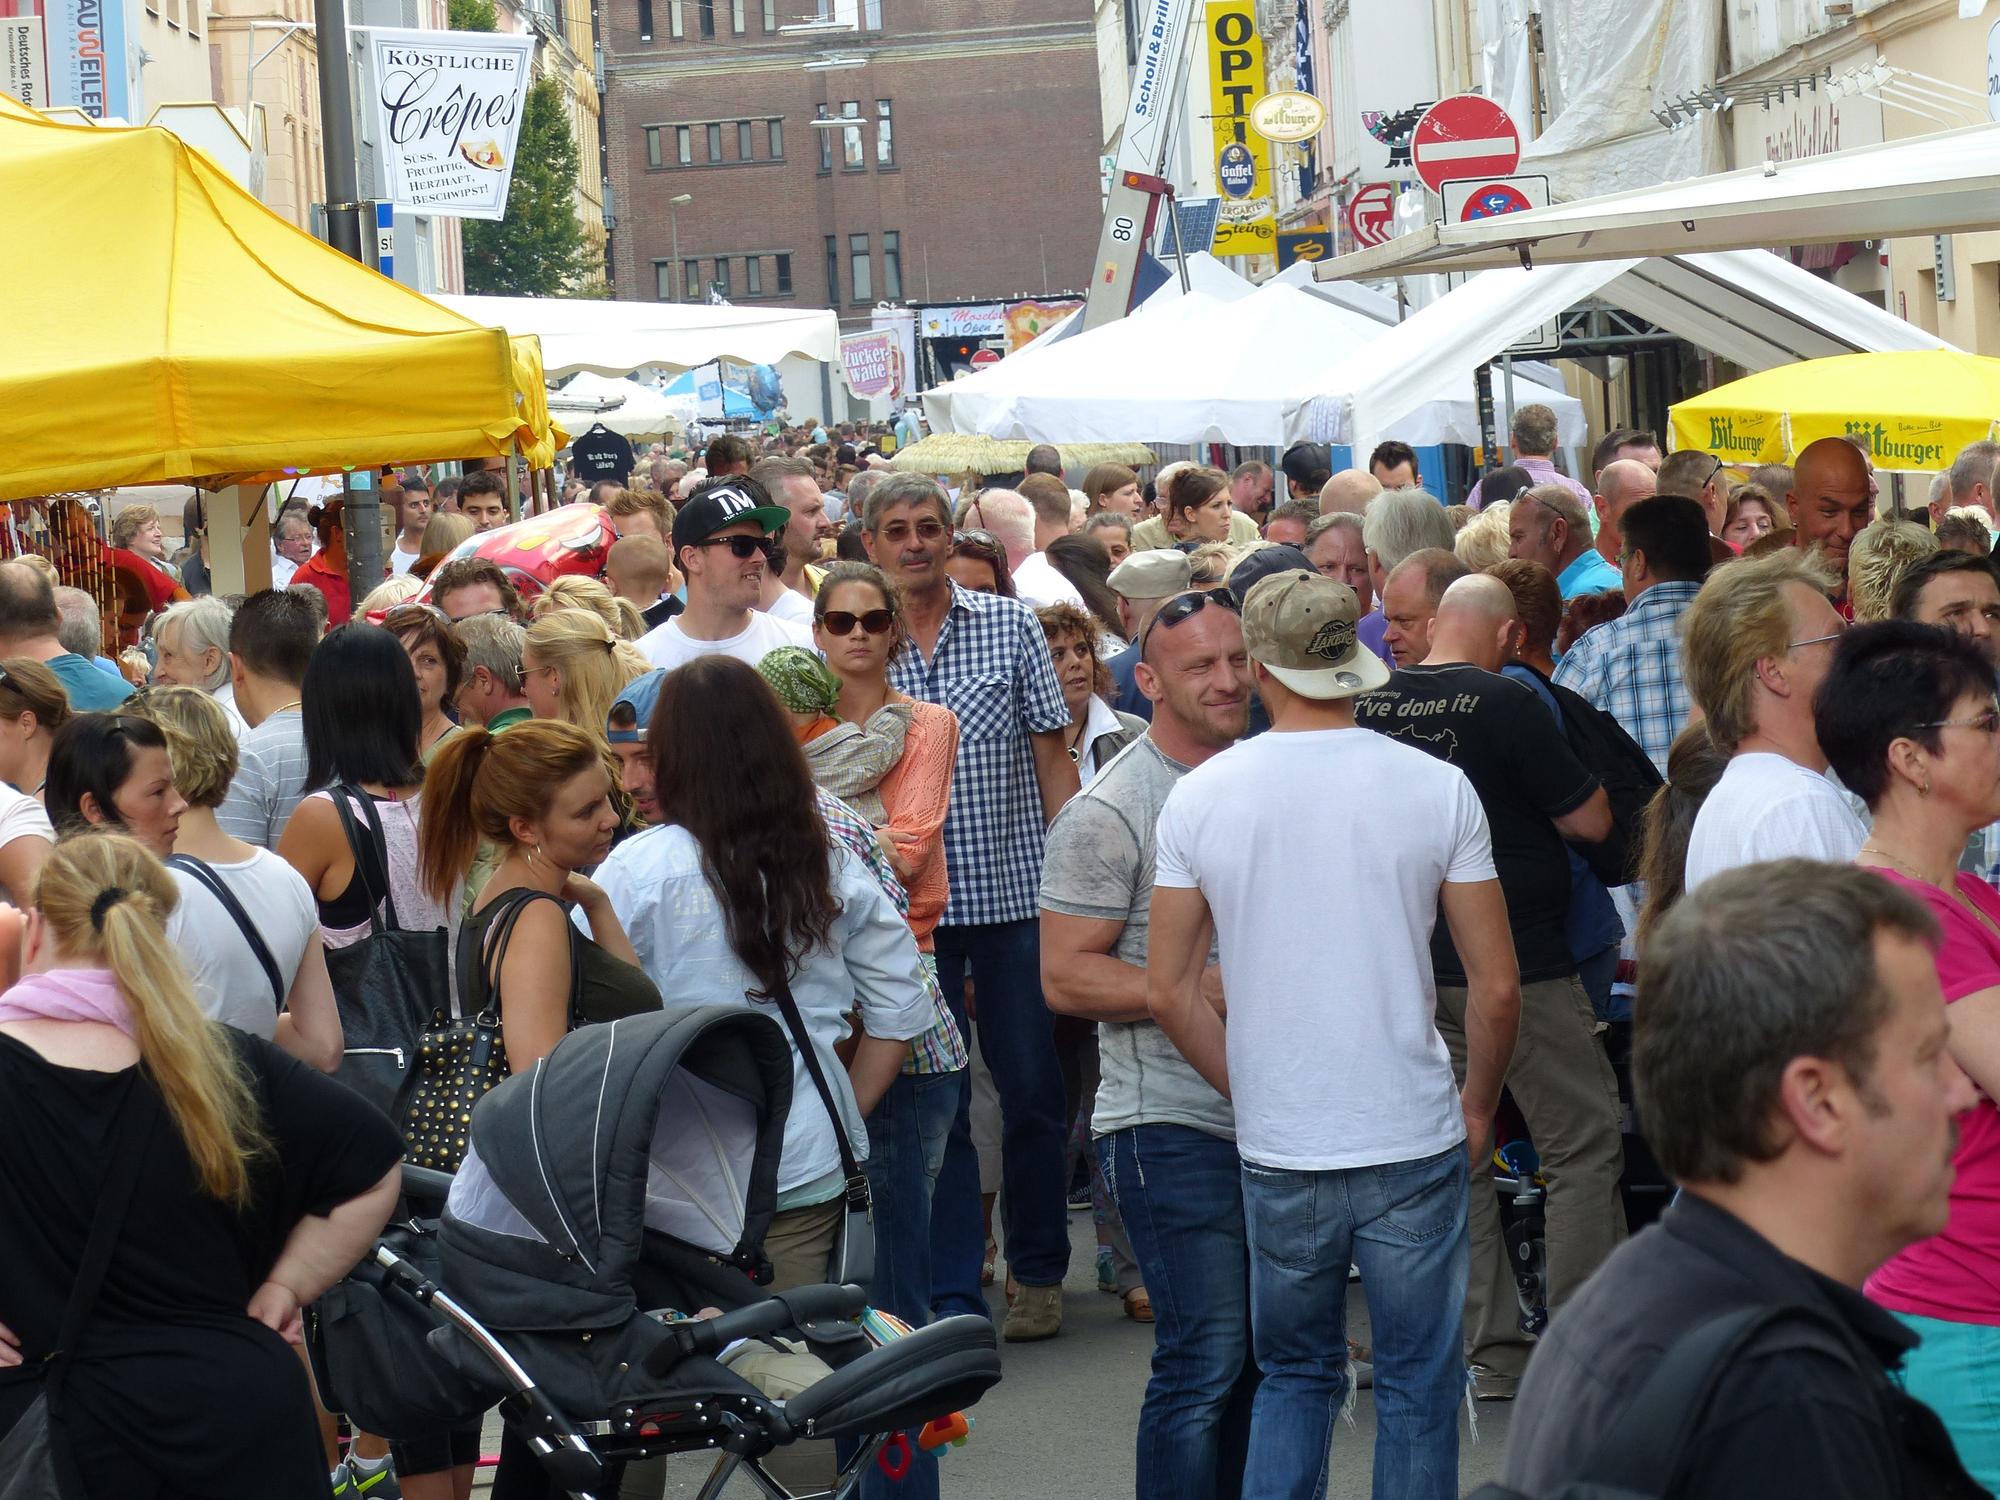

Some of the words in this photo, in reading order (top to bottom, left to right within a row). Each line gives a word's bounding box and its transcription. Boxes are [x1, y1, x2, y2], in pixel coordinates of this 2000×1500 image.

[18, 26, 32, 79] Deutsches
[387, 50, 515, 71] KÖSTLICHE
[1135, 55, 1158, 116] Scholl
[1149, 41, 1161, 55] &
[1148, 46, 1168, 118] Dachdeckermeister
[1164, 22, 1173, 45] GmbH
[1215, 13, 1258, 187] OPTI
[380, 67, 518, 158] Crêpes
[403, 153, 437, 165] SÜSS,
[406, 162, 467, 178] FRUCHTIG,
[1221, 164, 1253, 177] Gaffel
[409, 175, 475, 192] HERZHAFT,
[411, 184, 489, 205] BESCHWIPST!
[1113, 217, 1133, 241] 80
[1353, 698, 1392, 718] I've
[1397, 698, 1447, 717] done
[1451, 693, 1480, 713] it!
